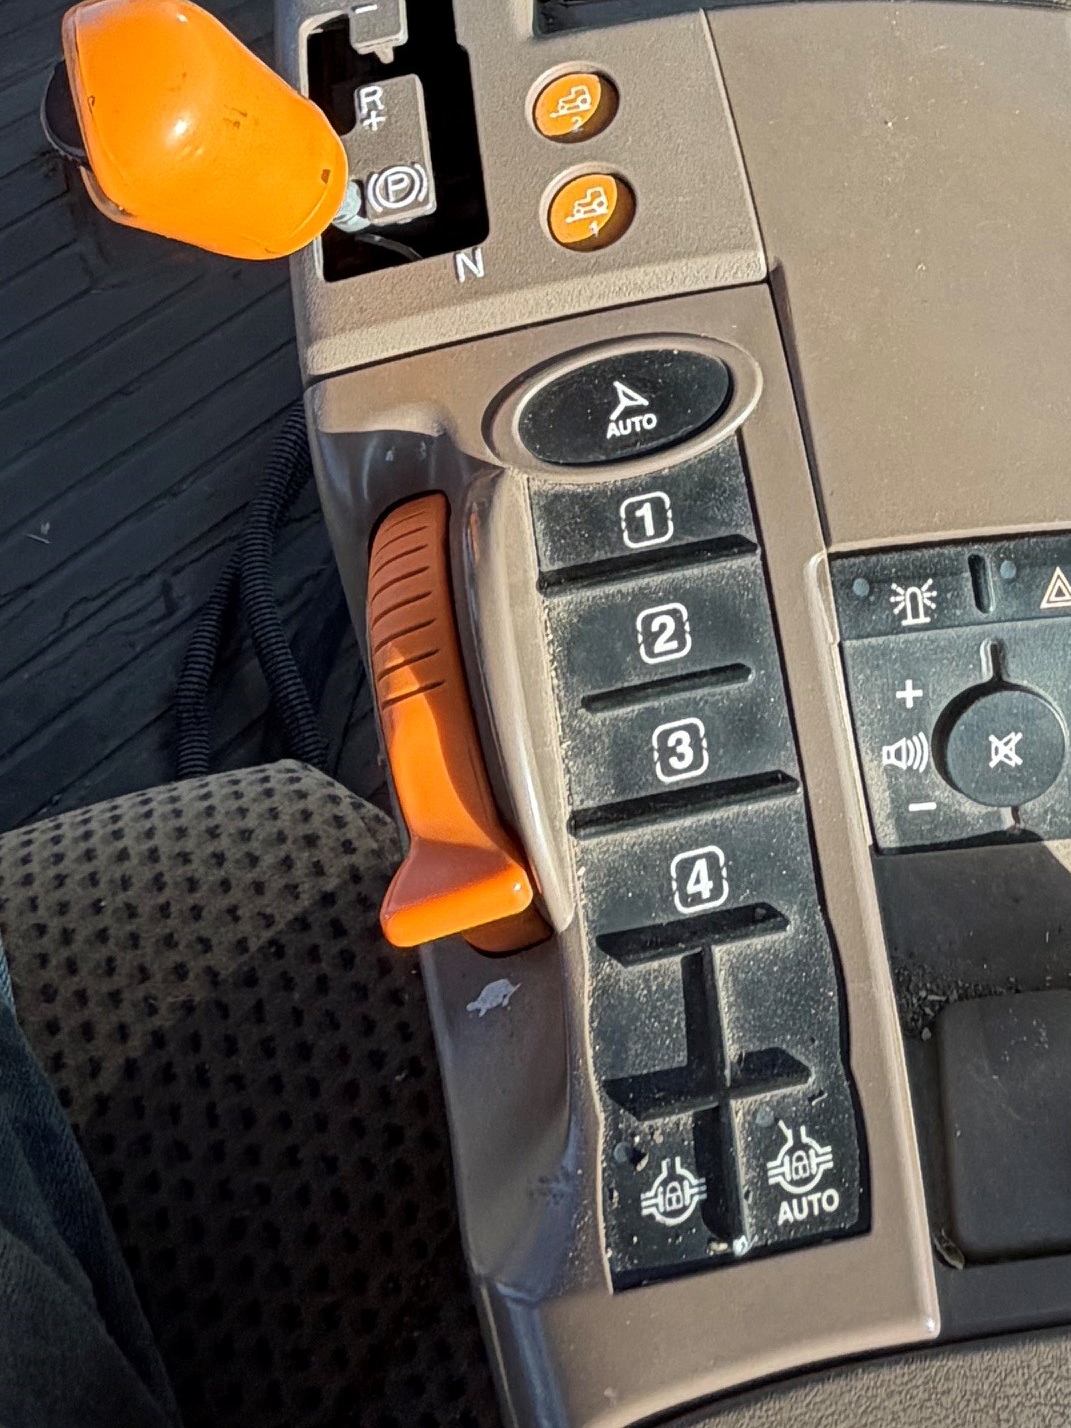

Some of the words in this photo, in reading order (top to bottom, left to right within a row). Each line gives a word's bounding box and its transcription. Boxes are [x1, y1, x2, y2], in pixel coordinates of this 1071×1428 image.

[359, 85, 384, 114] R
[386, 173, 409, 199] P
[454, 247, 485, 283] N
[606, 412, 658, 439] AUTO
[635, 501, 656, 536] 1
[651, 614, 679, 654] 2
[667, 730, 694, 771] 3
[686, 858, 714, 899] 4
[777, 1188, 840, 1226] AUTO
